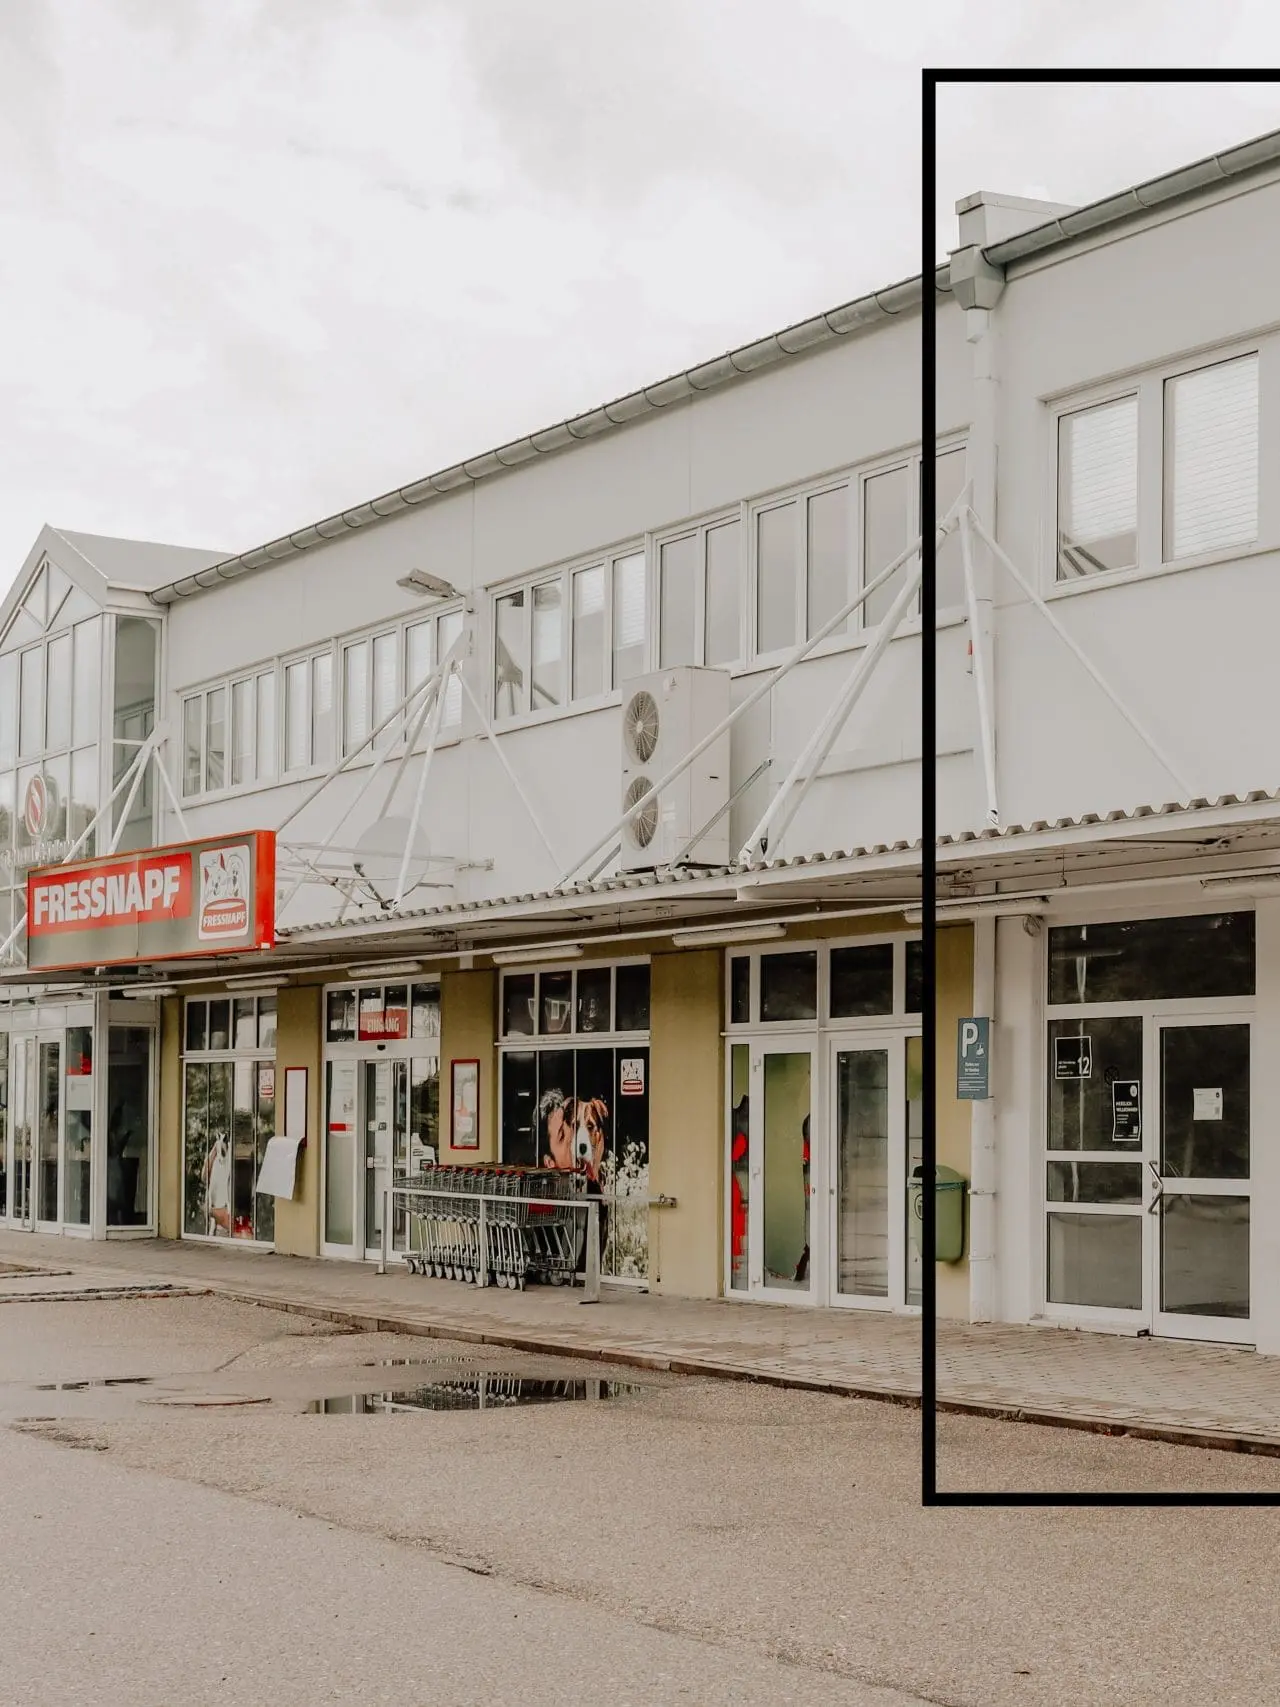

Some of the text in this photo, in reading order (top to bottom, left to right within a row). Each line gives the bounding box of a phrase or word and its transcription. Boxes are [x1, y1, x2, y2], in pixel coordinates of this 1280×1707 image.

[34, 865, 181, 926] FRESSNAPF
[202, 910, 246, 928] FRESSNAPF
[961, 1022, 979, 1058] P
[1077, 1056, 1090, 1075] 12
